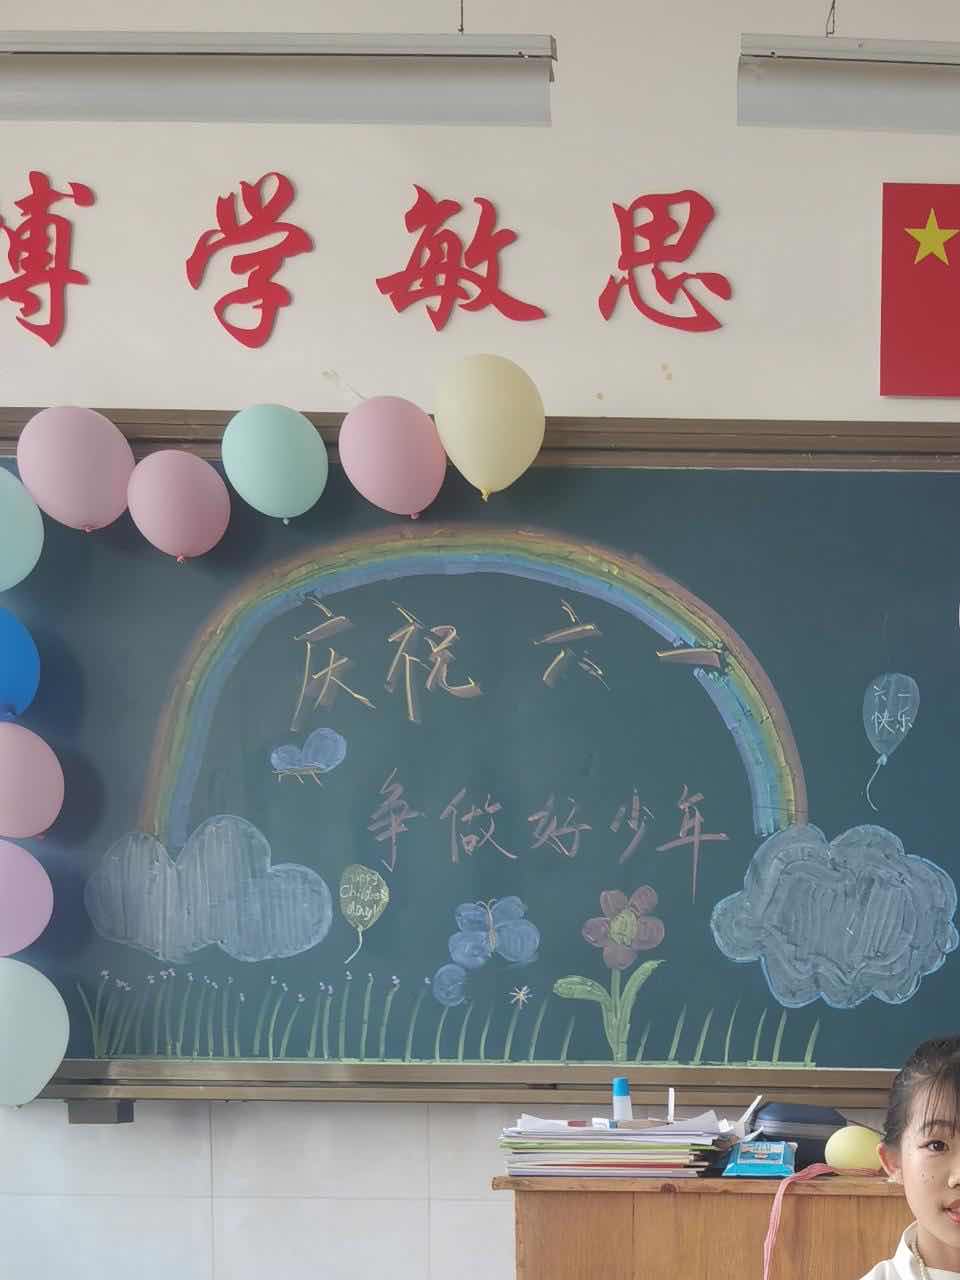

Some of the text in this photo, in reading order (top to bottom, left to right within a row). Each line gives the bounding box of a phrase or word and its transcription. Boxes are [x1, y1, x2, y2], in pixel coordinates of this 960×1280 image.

[871, 707, 913, 735] 快乐
[369, 768, 729, 904] 争做好少年
